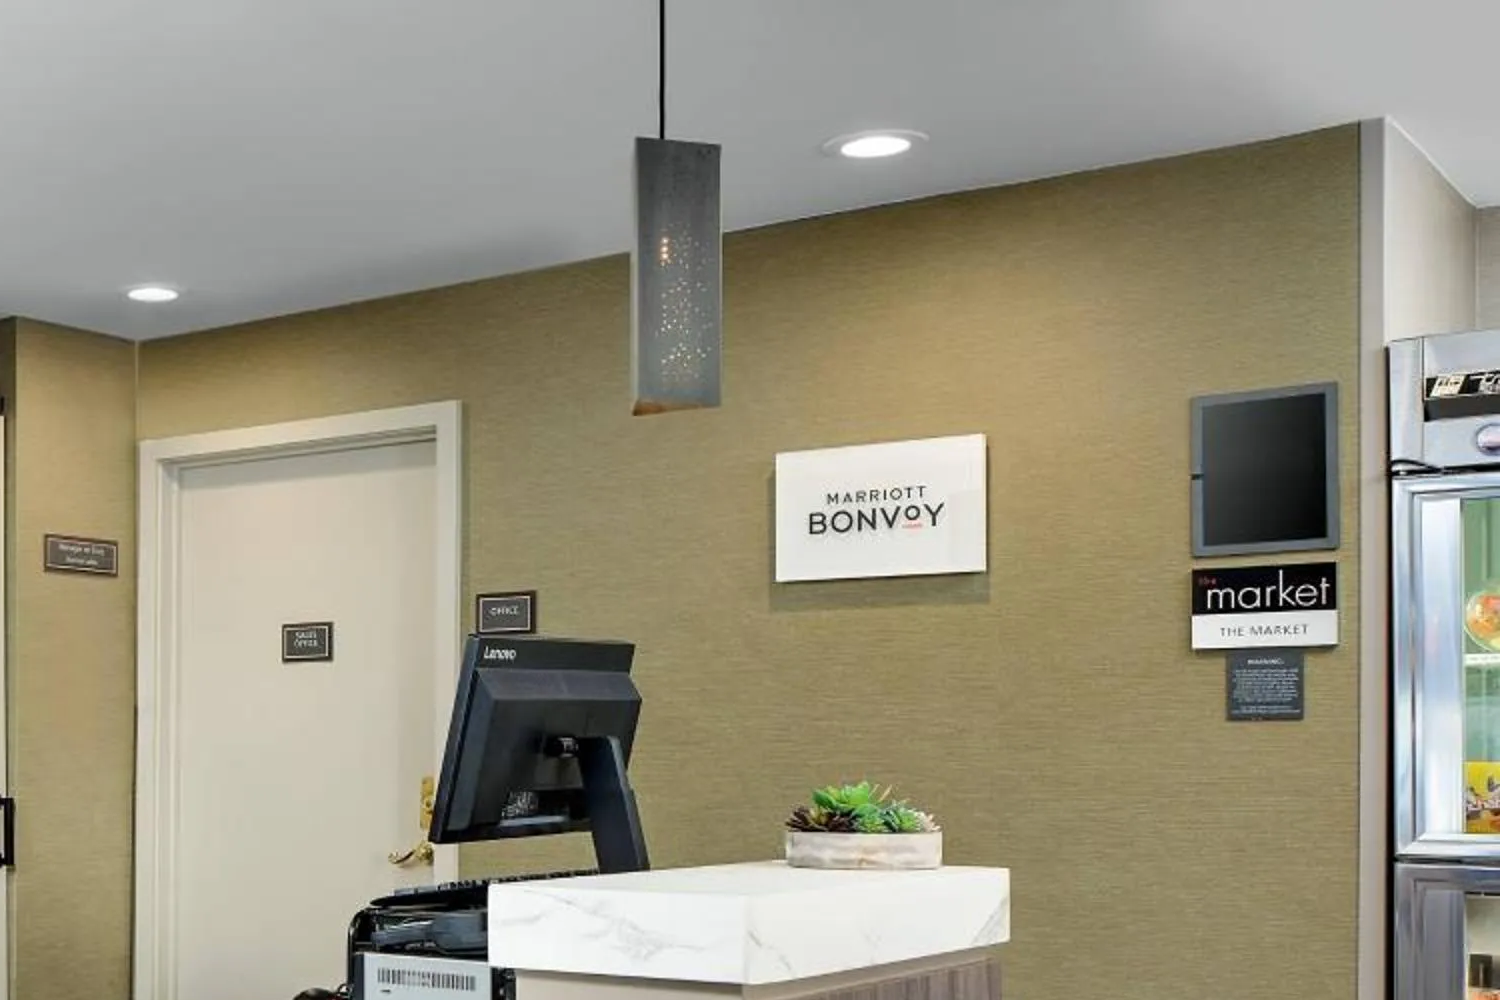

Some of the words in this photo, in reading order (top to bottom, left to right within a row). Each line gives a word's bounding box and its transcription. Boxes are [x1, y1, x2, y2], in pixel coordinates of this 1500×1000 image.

[826, 485, 927, 505] MARRIOTT
[808, 502, 945, 535] BONVOY
[1207, 569, 1331, 609] market
[1220, 627, 1246, 637] THE
[1249, 624, 1309, 637] MARKET
[483, 646, 517, 660] Lenovo
